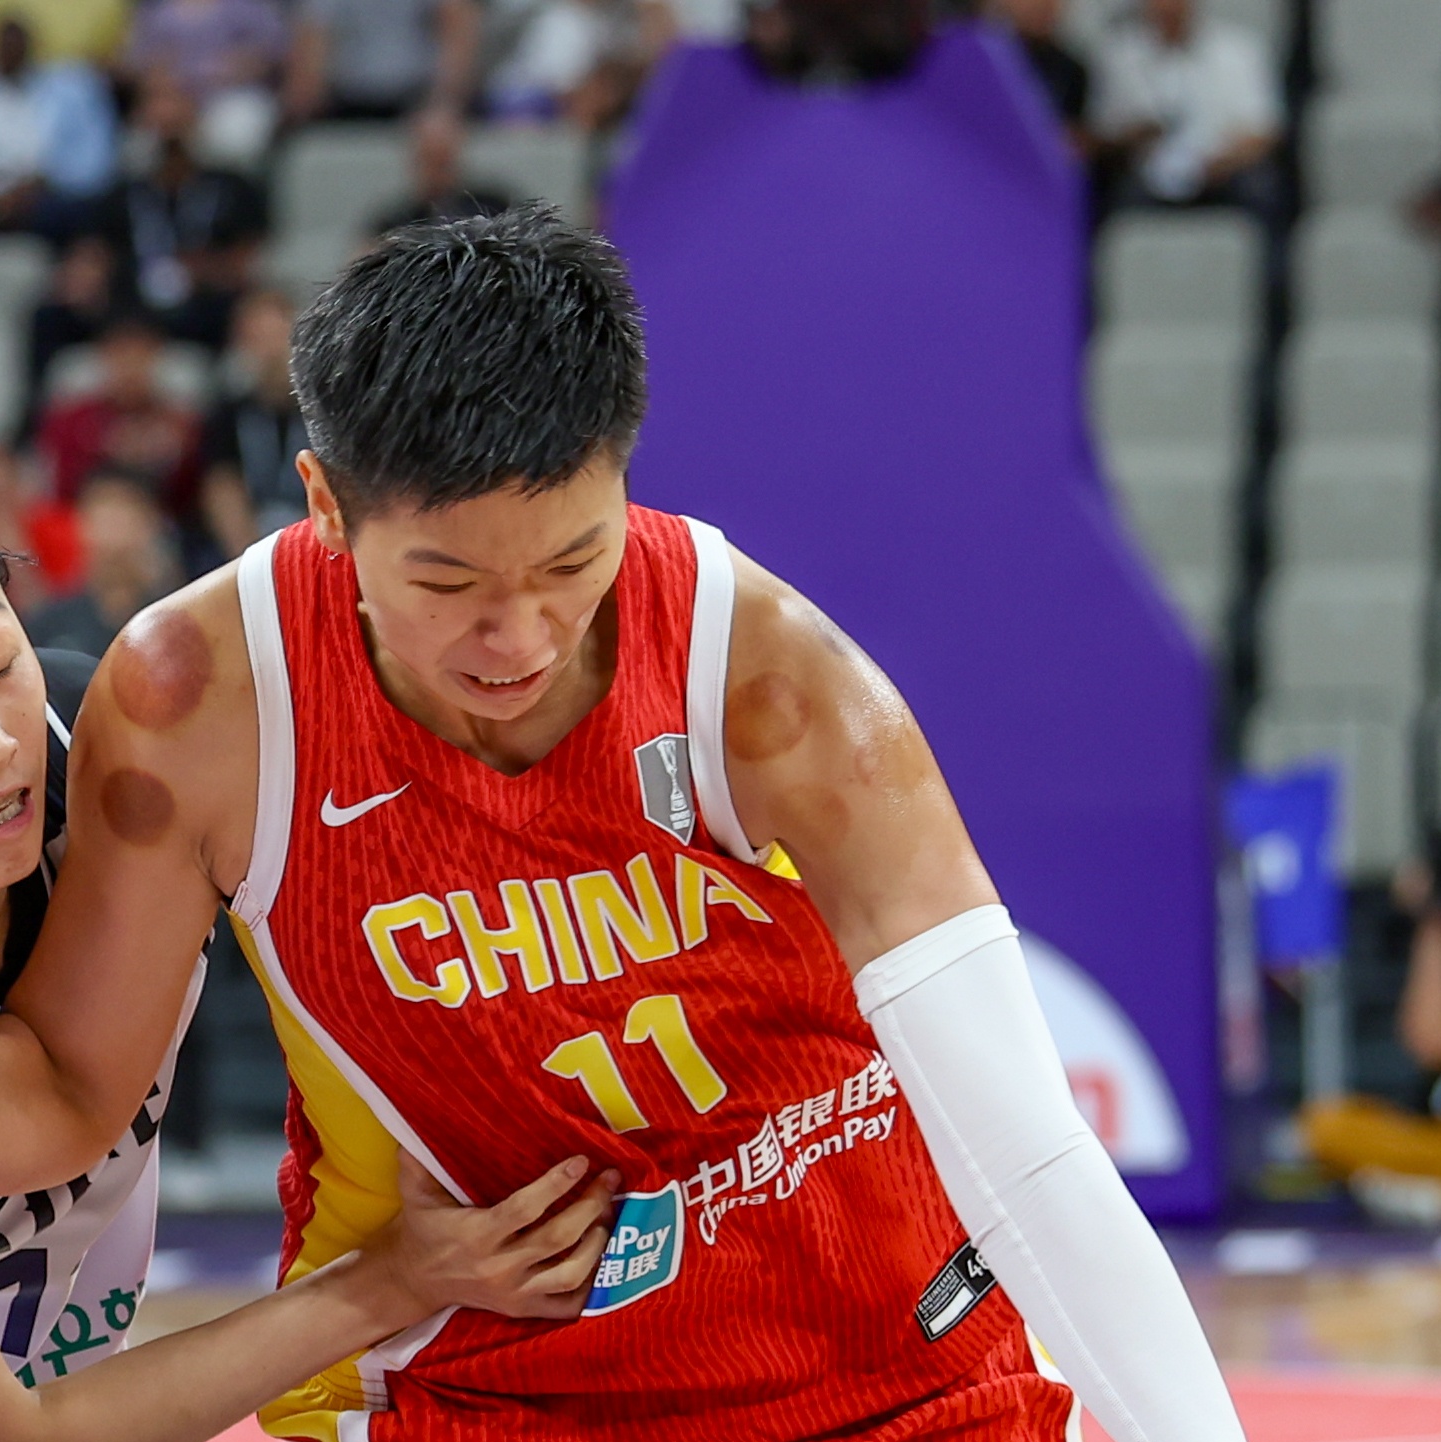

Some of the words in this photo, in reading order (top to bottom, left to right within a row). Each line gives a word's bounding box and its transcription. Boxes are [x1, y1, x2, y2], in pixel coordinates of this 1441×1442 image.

[362, 852, 772, 1008] CHINA
[541, 994, 727, 1135] 11
[681, 1050, 897, 1206] 中国银联
[605, 1225, 671, 1253] nPay
[699, 1192, 768, 1246] China
[775, 1106, 896, 1200] UnionPay
